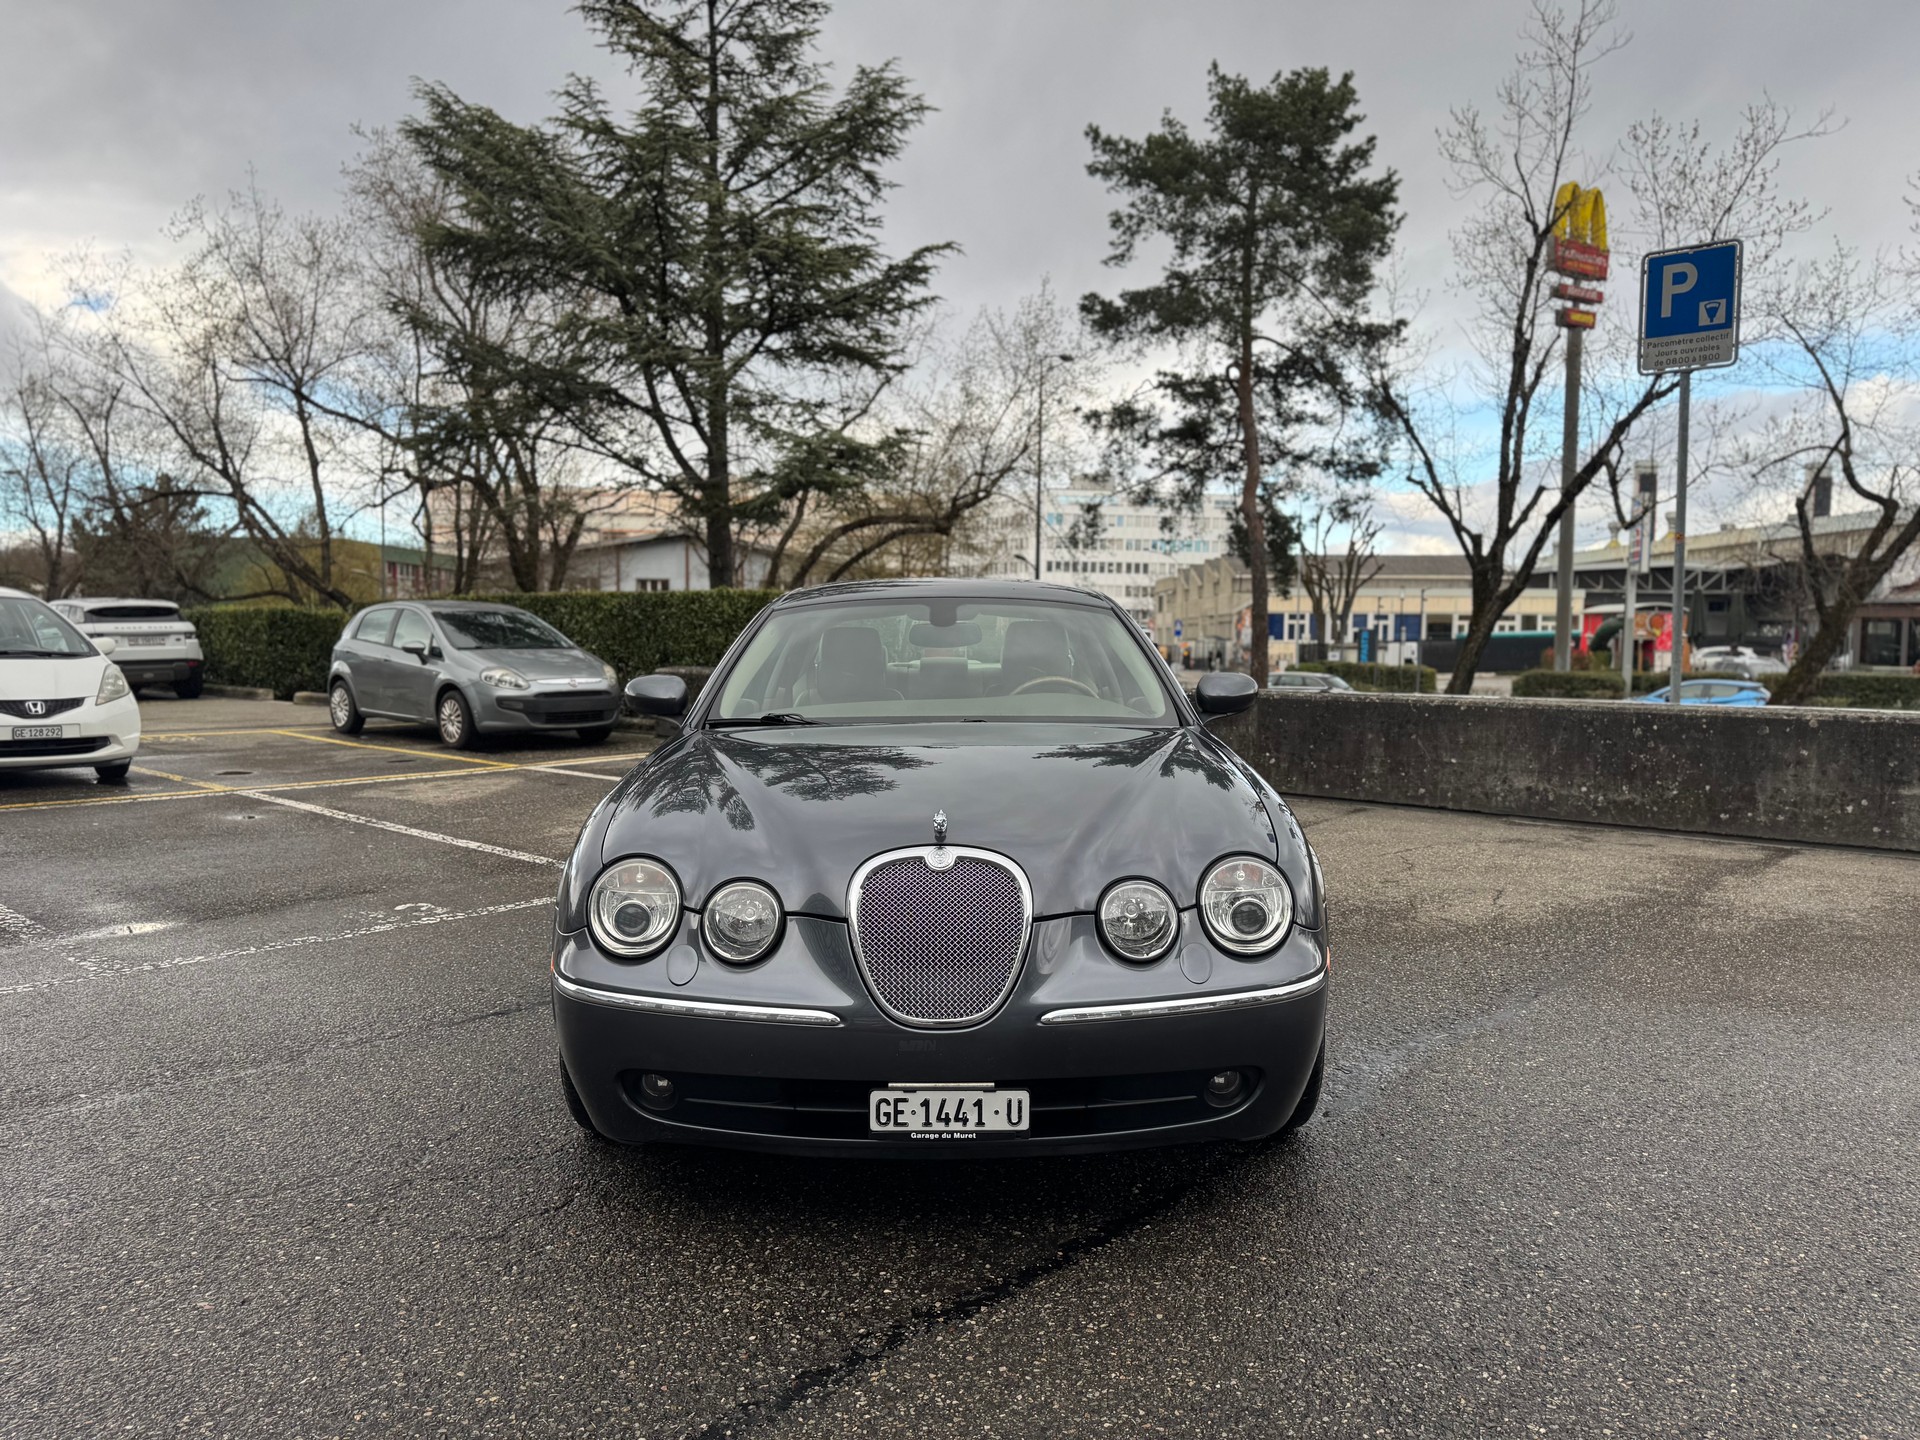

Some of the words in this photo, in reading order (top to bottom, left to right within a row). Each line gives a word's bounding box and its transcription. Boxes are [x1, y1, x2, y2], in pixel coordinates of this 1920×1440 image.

[1661, 262, 1698, 318] P
[1647, 338, 1694, 349] Parcomètre
[1695, 333, 1729, 343] collectif
[1655, 349, 1678, 357] Jours
[1680, 344, 1720, 355] ouvrables
[911, 1132, 939, 1140] Garage
